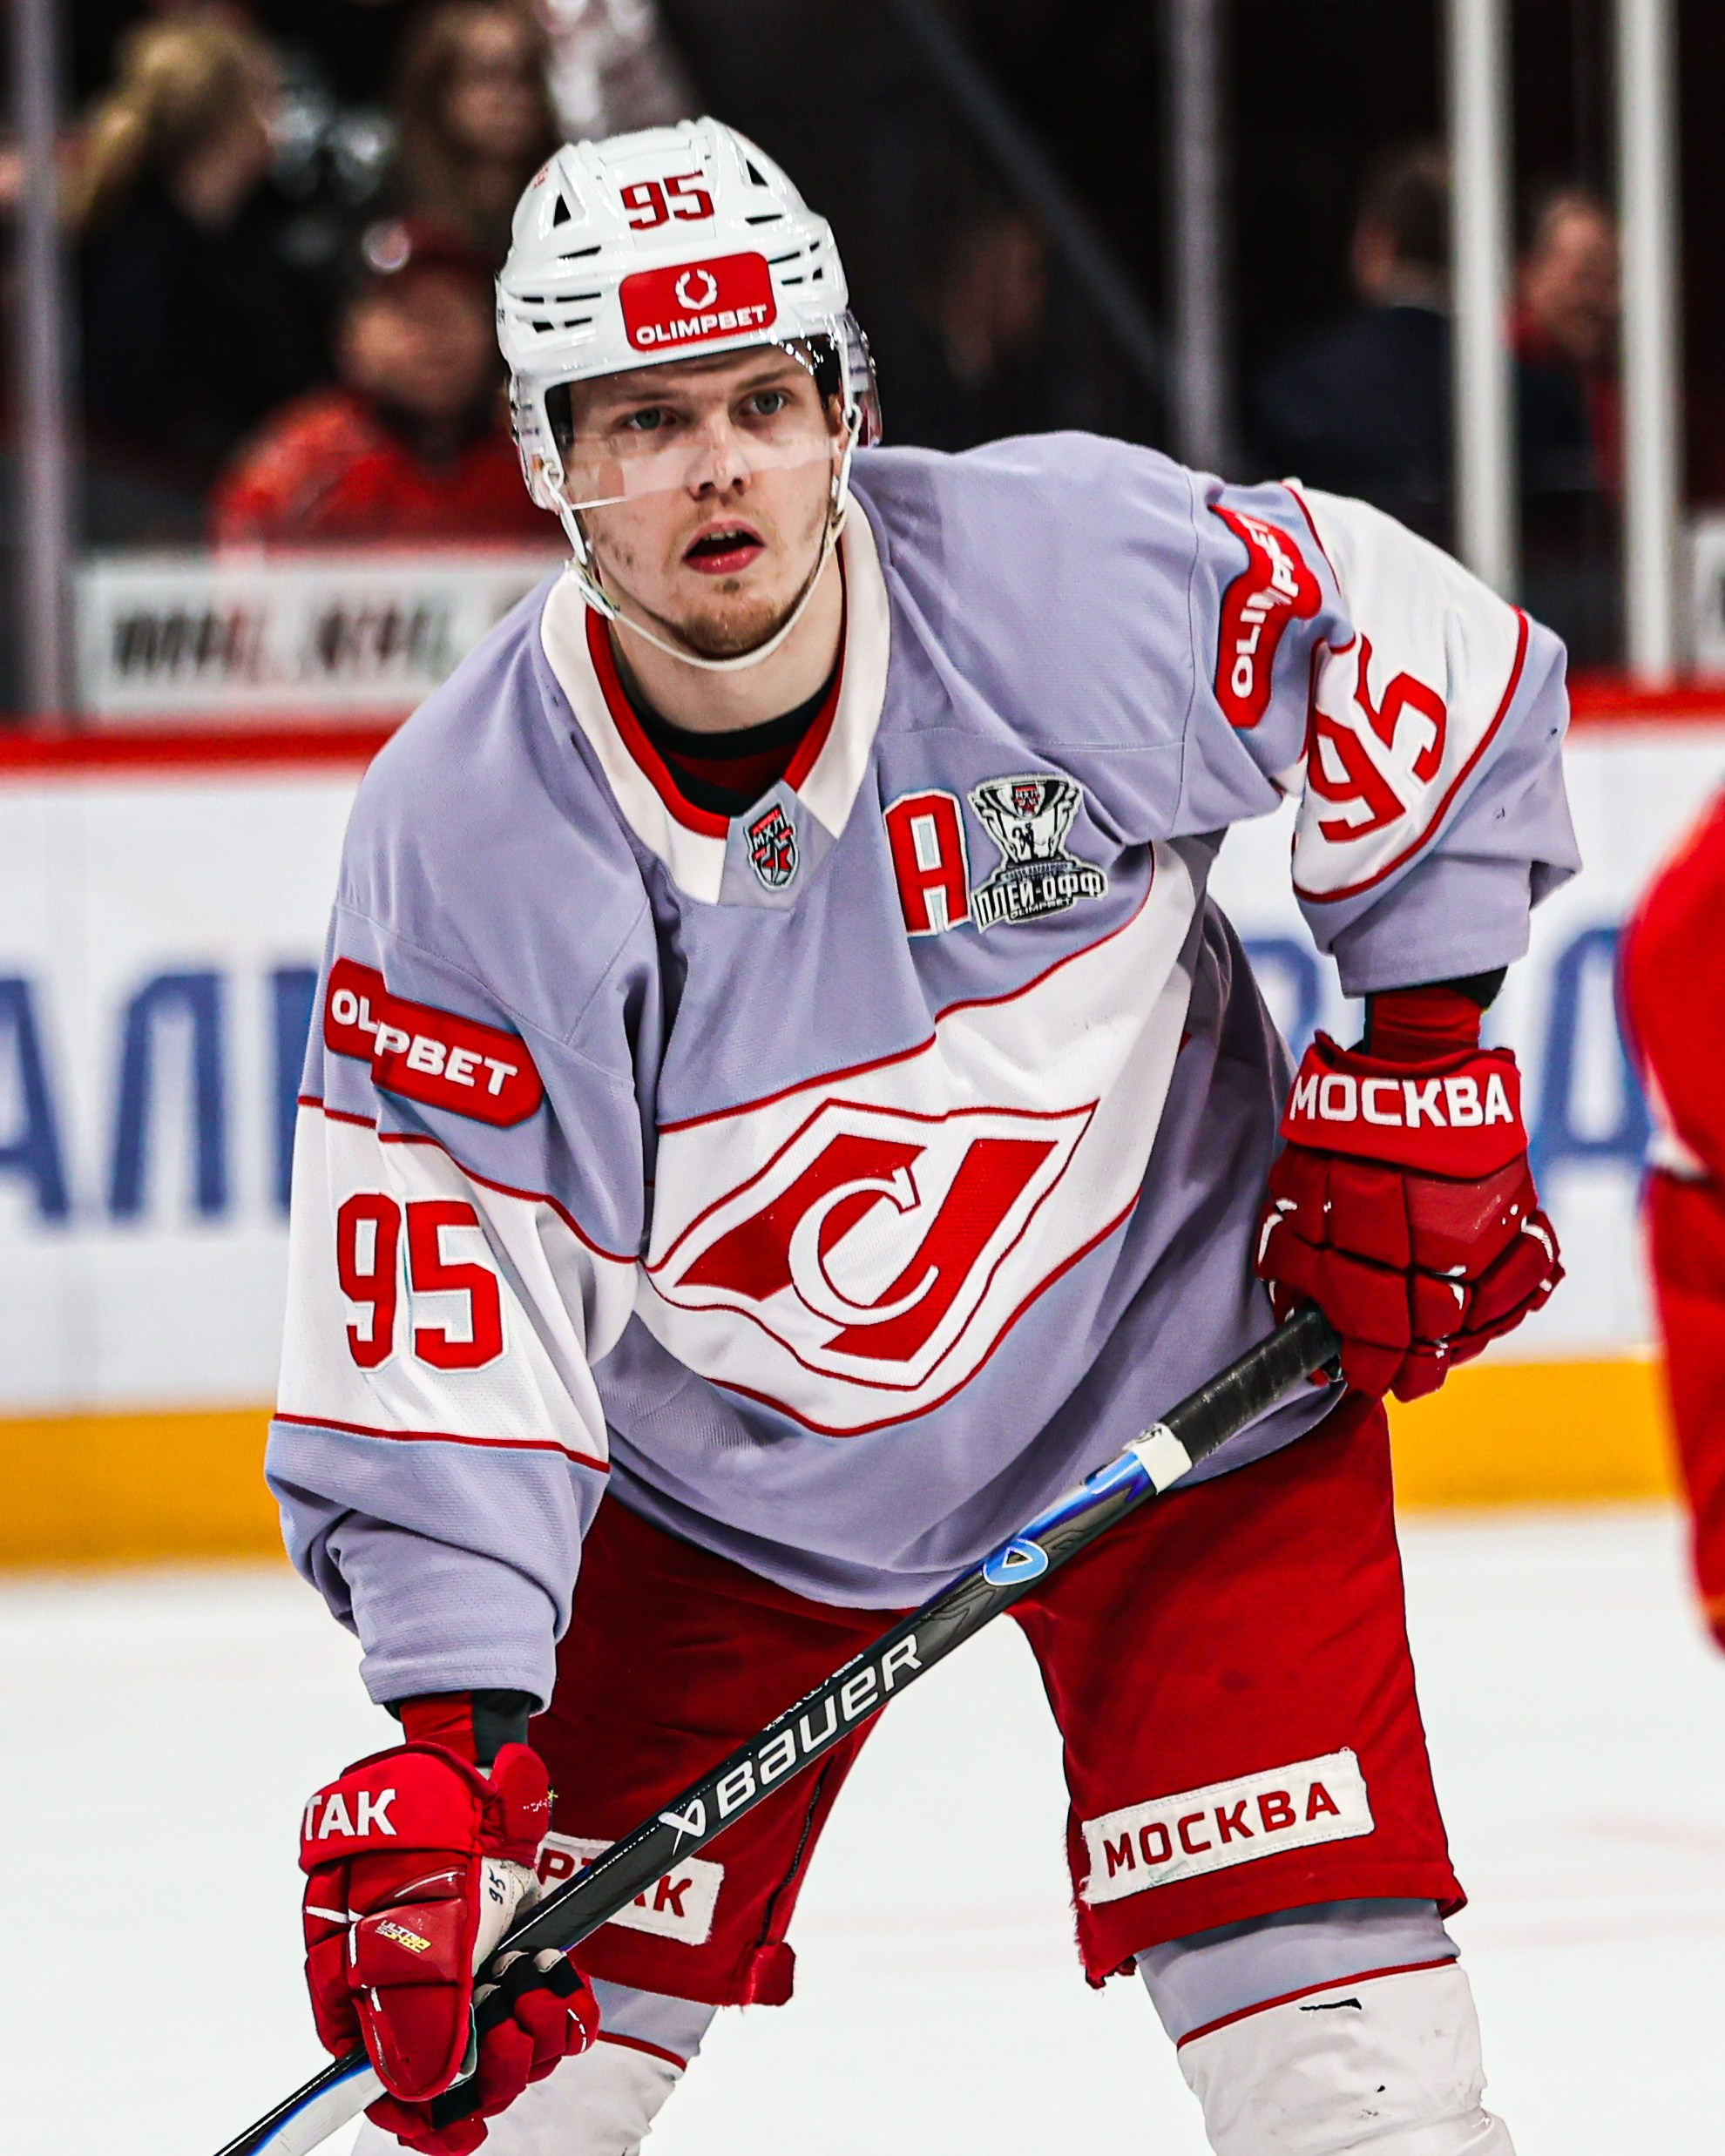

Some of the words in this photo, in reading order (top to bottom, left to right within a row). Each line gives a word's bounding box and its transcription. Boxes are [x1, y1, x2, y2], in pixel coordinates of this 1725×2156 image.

[619, 170, 714, 230] 95
[636, 304, 768, 345] OLIMPBET
[1308, 631, 1447, 843] 95
[883, 790, 970, 936] A
[977, 873, 1102, 927] ПЛЕЙ-ОФФ
[331, 988, 518, 1097] OLPBET
[1289, 1073, 1514, 1128] МОСКВА
[336, 1193, 504, 1370] 95
[1102, 1781, 1342, 1879] МОСКВА
